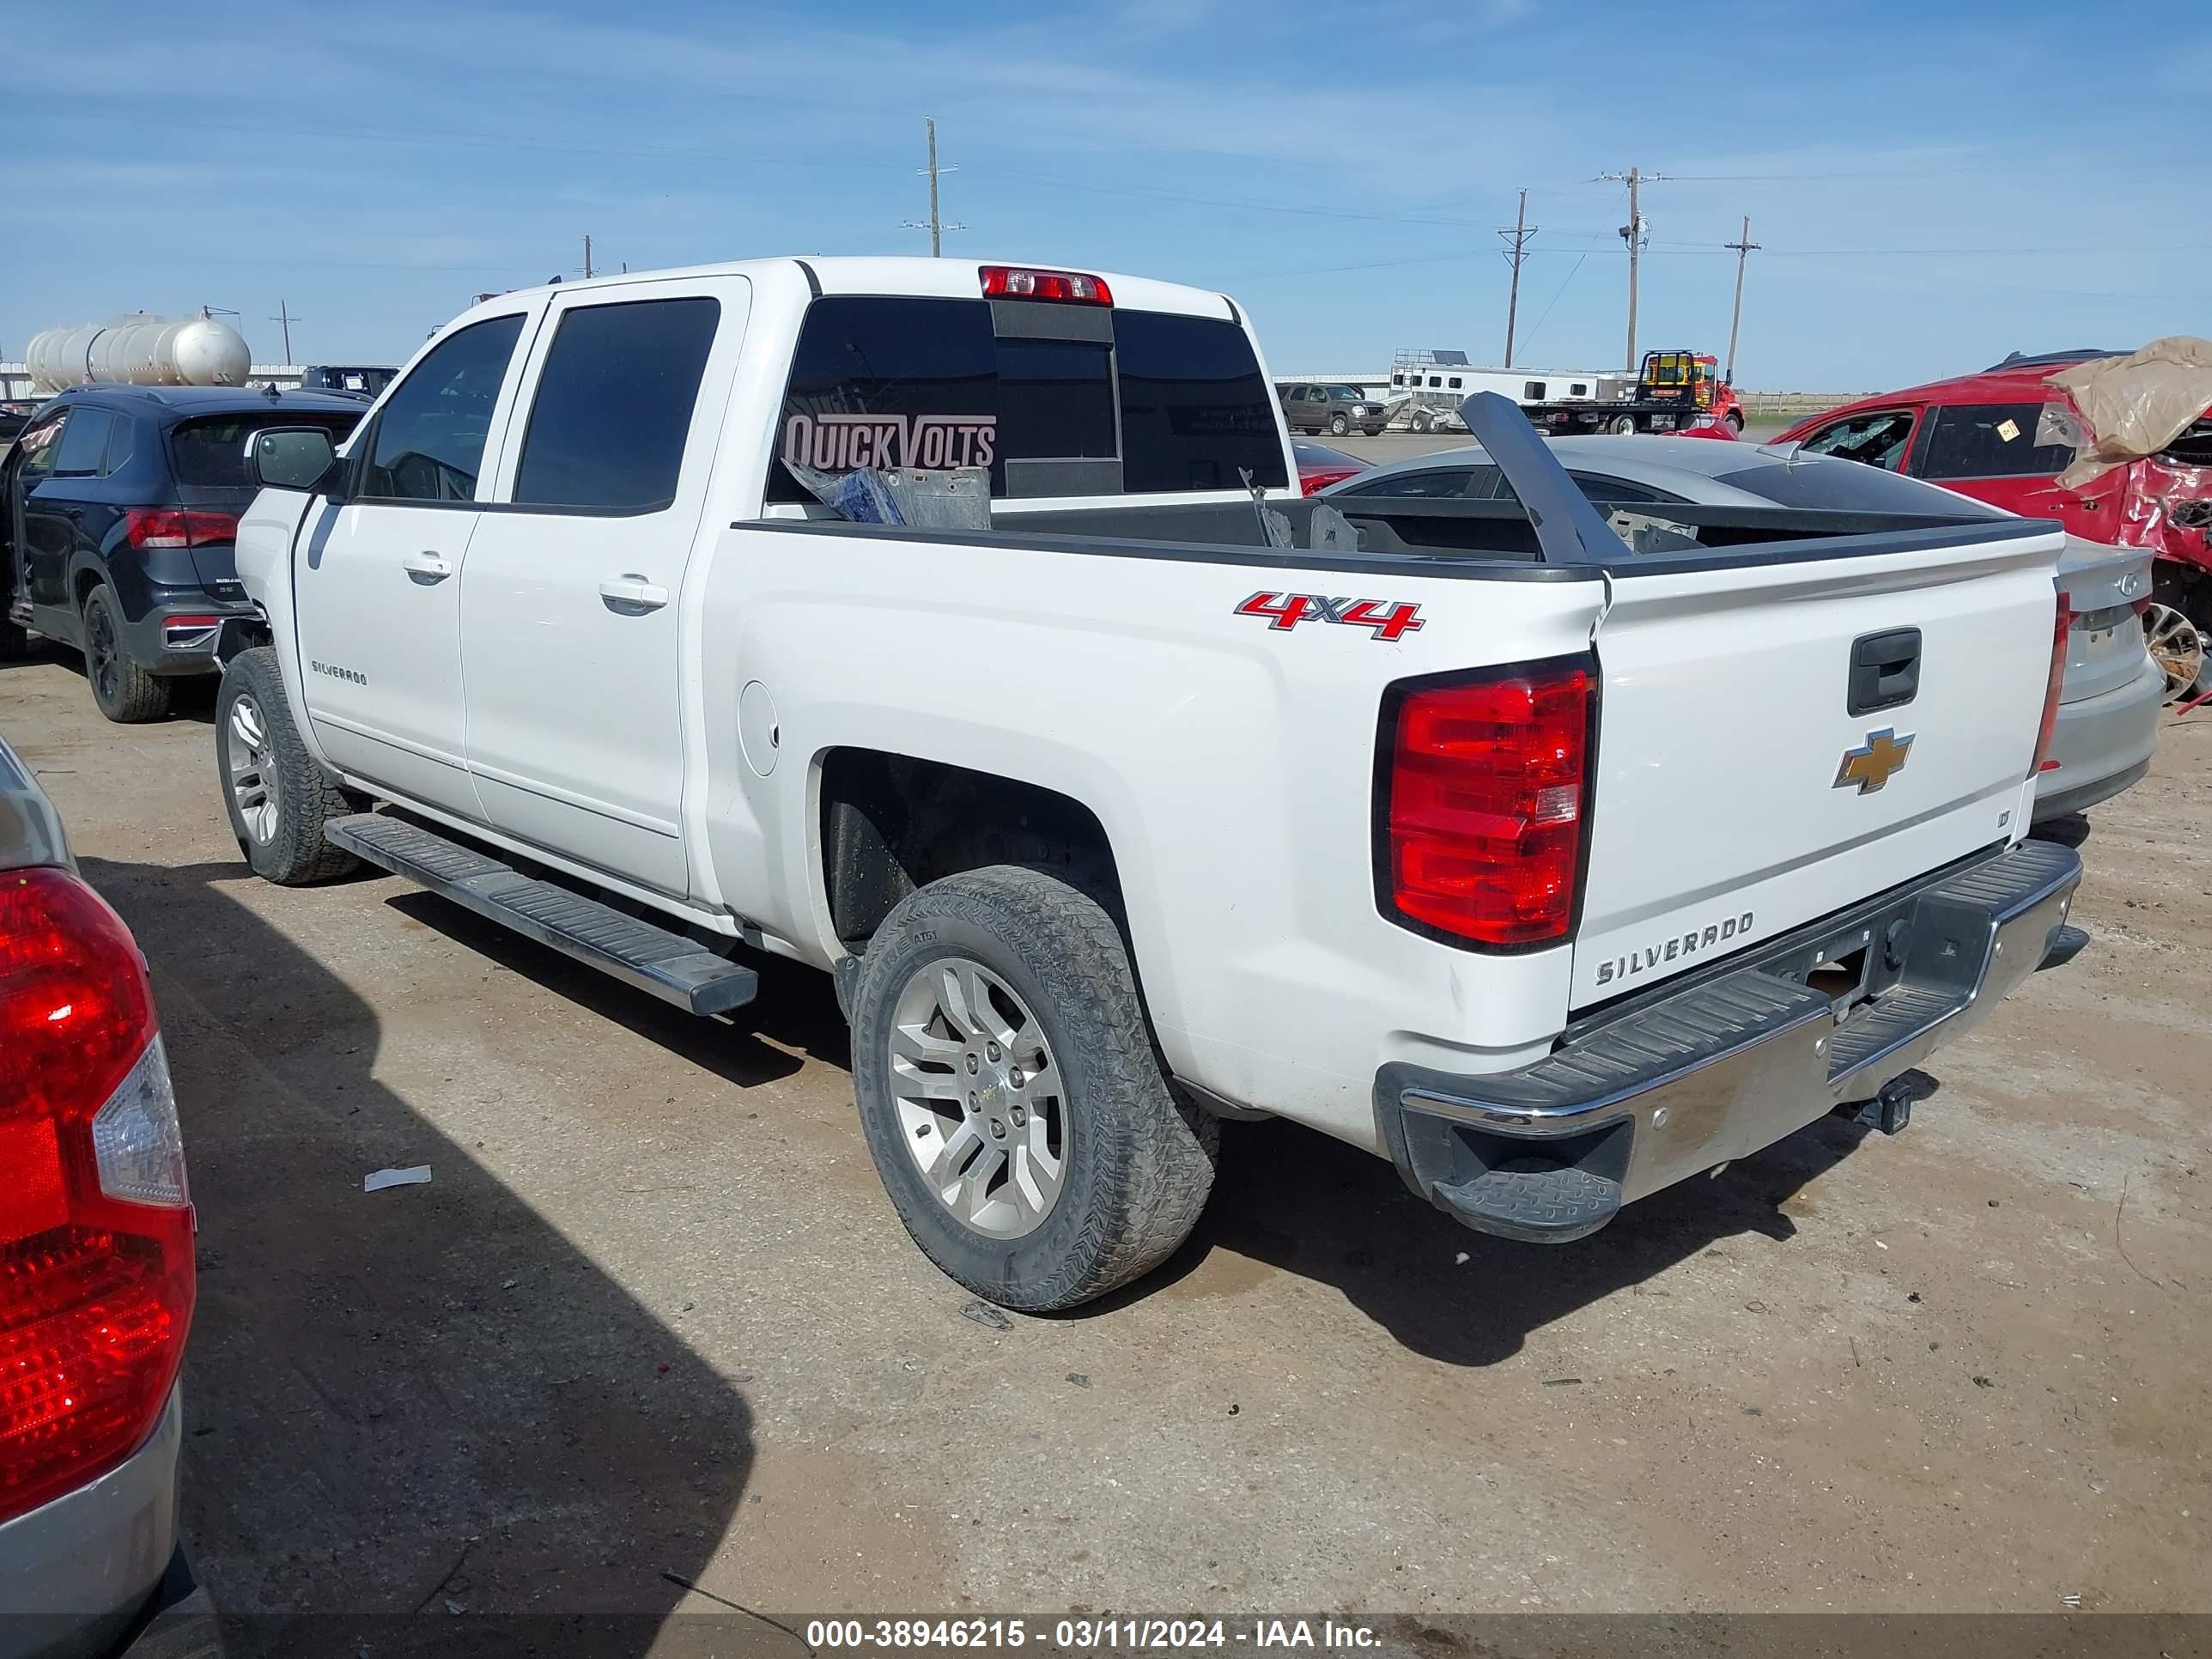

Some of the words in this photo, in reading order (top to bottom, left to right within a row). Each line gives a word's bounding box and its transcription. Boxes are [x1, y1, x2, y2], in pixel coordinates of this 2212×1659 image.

[311, 660, 368, 686] SILVERADO
[913, 929, 938, 945] AT51
[1595, 912, 1754, 987] SILVERADO
